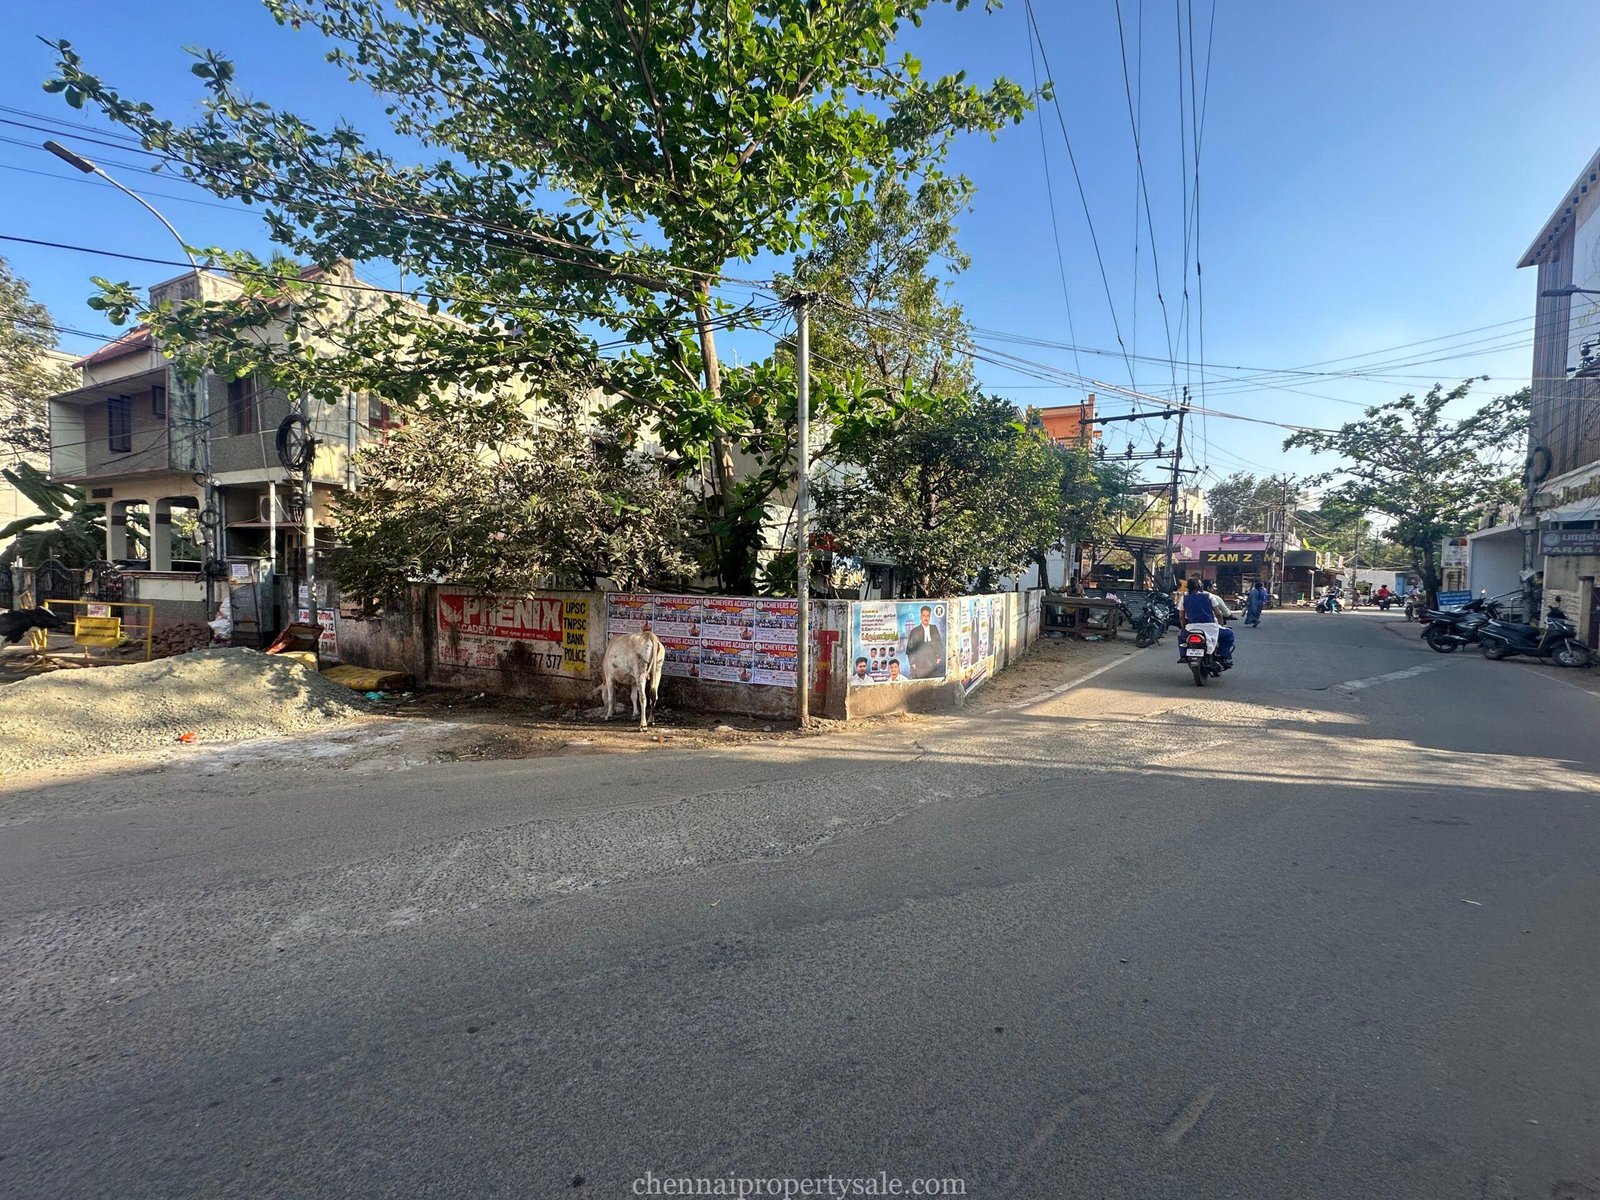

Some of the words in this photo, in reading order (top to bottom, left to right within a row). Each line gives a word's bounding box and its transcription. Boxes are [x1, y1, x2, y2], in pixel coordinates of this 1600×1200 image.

[1207, 553, 1239, 562] ZAM
[565, 602, 586, 614] UPSC
[709, 599, 734, 607] ACHIEVERS
[763, 601, 789, 609] ACHIEVERS
[463, 597, 562, 632] PHENIX
[563, 617, 587, 630] TNPSC
[566, 632, 585, 645] BANK
[708, 640, 732, 648] ACHIEVERS
[732, 641, 753, 649] ACADEMY
[762, 643, 787, 651] ACHIEVERS
[564, 647, 586, 662] POLICE
[546, 654, 563, 670] 377
